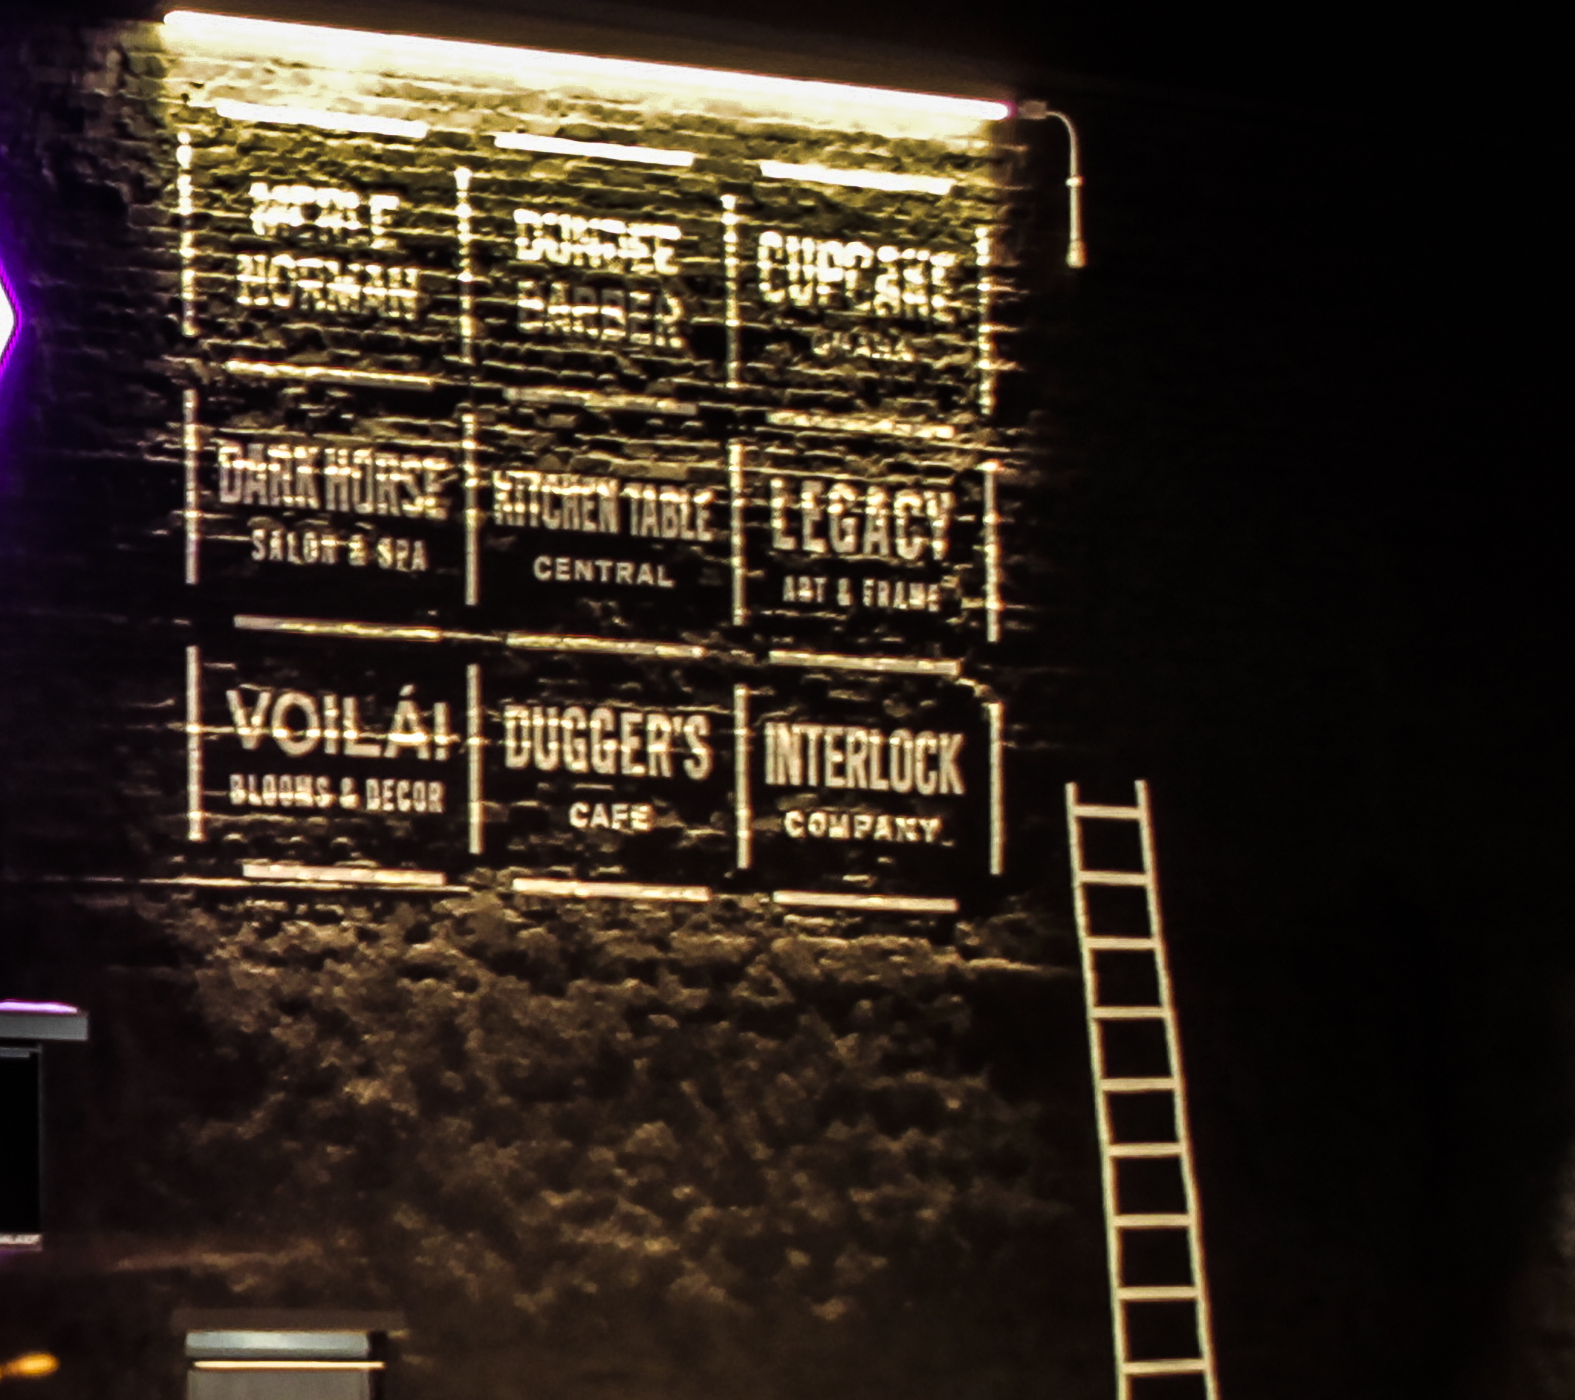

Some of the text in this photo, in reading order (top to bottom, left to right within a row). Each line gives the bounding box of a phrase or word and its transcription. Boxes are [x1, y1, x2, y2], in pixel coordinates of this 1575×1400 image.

[236, 253, 420, 321] NORMAN
[218, 443, 447, 520] DARK HORSE
[493, 470, 713, 541] KITCHEN TABLE
[770, 476, 955, 560] LEGACY
[251, 529, 339, 565] SALON
[377, 537, 427, 572] SPA
[533, 556, 675, 588] CENTRAL
[782, 574, 941, 612] ART & FRAME
[504, 704, 713, 781] DUGGER'S
[764, 720, 966, 796] INTERLOCK
[229, 773, 444, 813] BLOOMS & DECOR
[568, 802, 653, 831] CAFE
[783, 810, 942, 845] COMPANY
